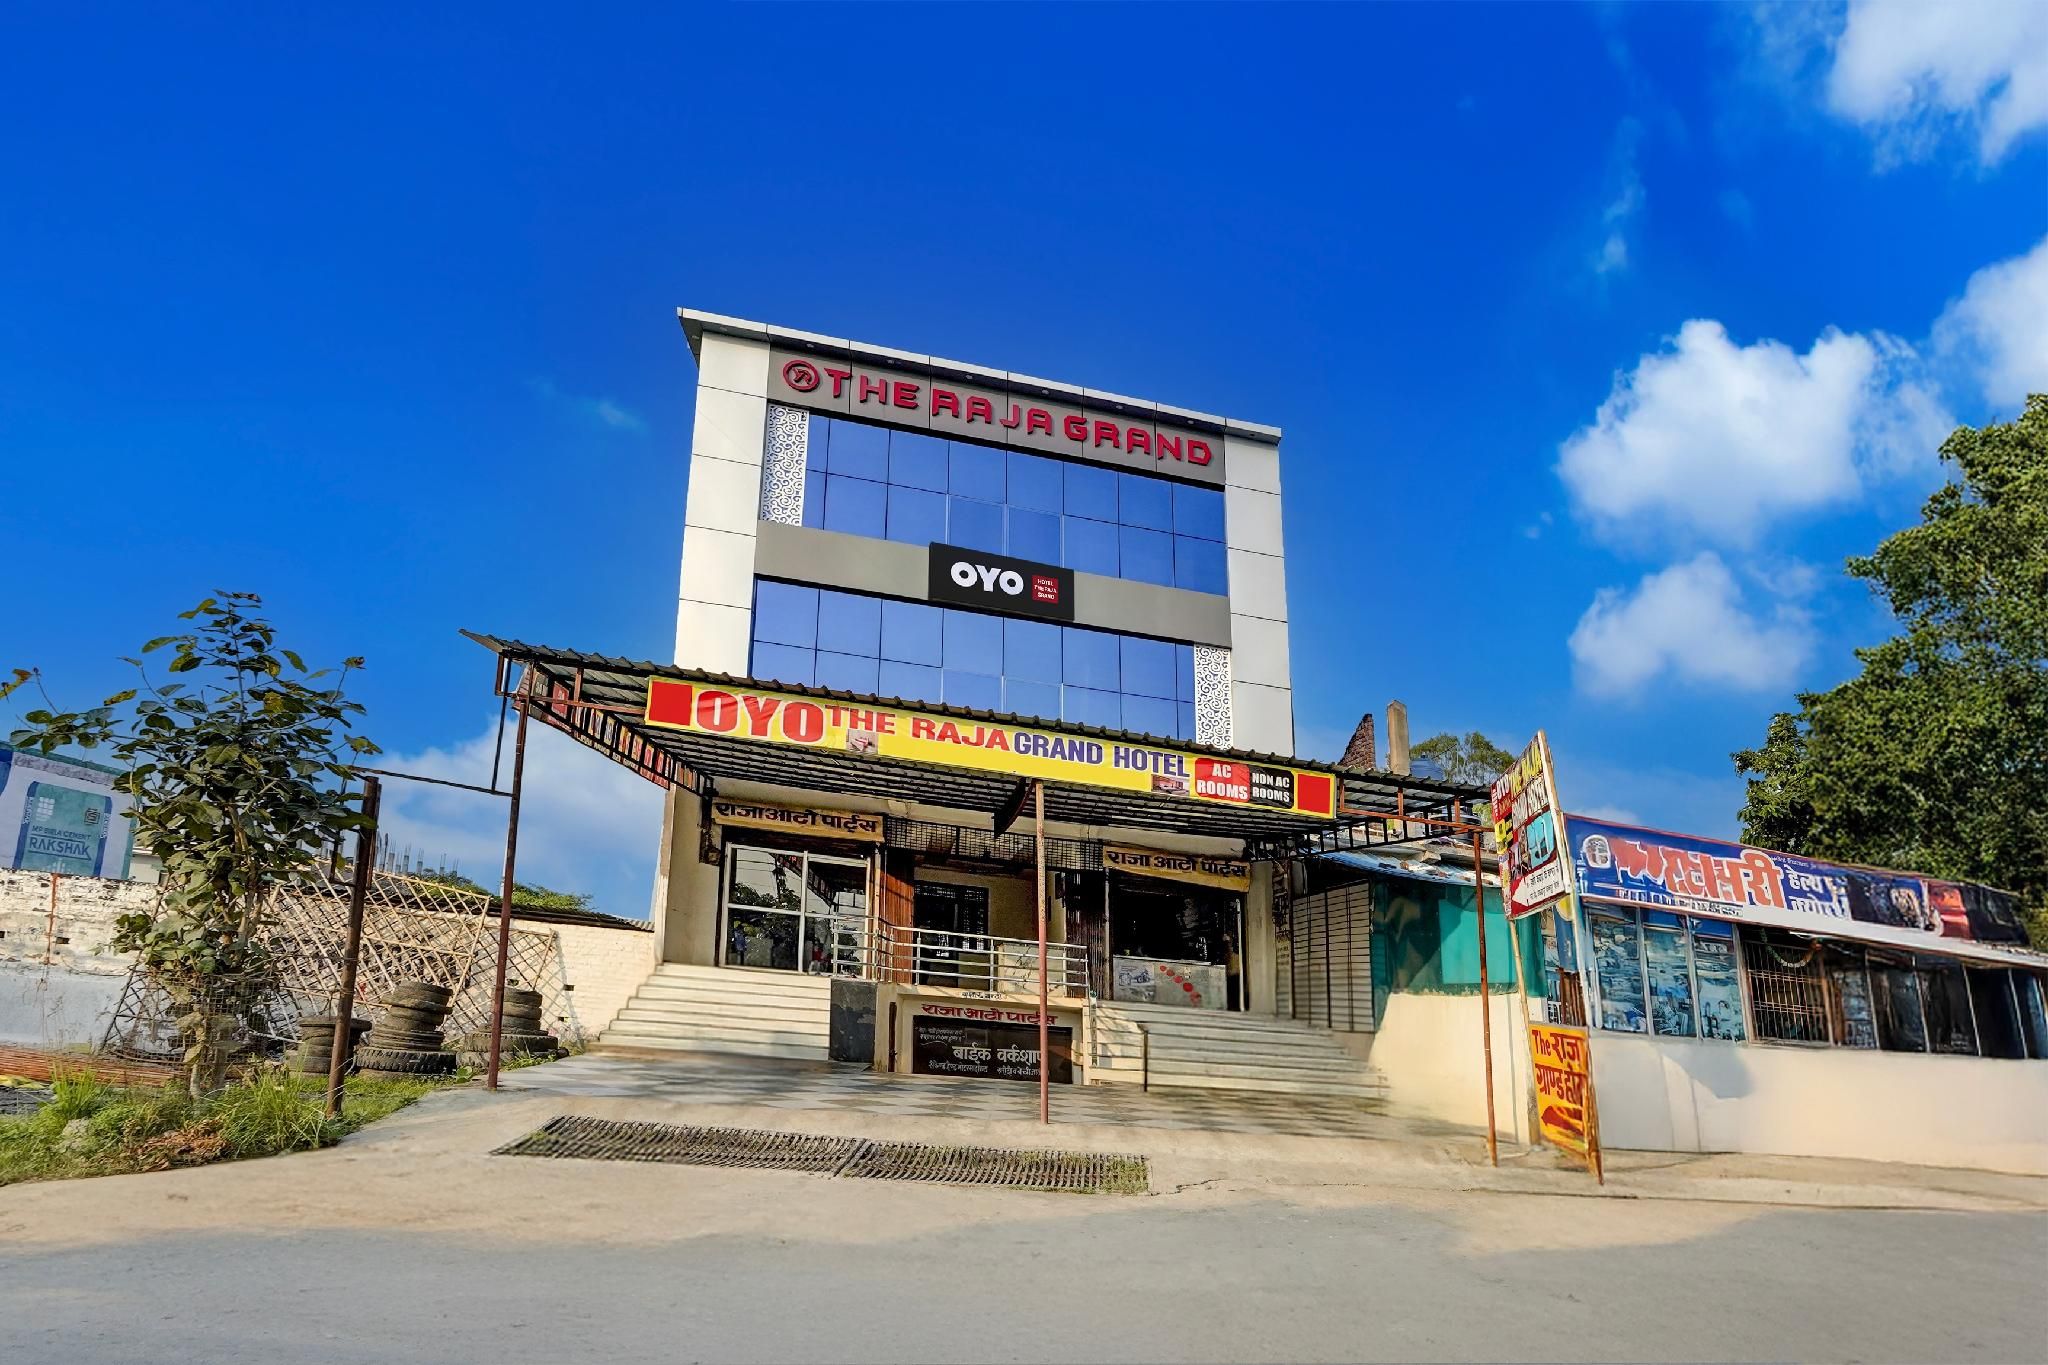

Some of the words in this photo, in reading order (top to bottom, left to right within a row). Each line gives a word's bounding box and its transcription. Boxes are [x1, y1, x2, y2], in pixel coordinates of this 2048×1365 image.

[824, 367, 920, 410] THE
[931, 388, 1053, 436] RAJA
[1063, 416, 1213, 467] GRAND
[950, 561, 1024, 596] OYO
[697, 690, 825, 743] OYO
[825, 705, 896, 735] THE
[912, 717, 1010, 752] RAJA
[1014, 732, 1103, 765] GRAND
[1114, 745, 1191, 778] HOTEL
[1212, 763, 1232, 778] AC
[1197, 779, 1249, 800] ROOMS
[1252, 772, 1274, 786] NON
[1274, 776, 1290, 789] AC
[1252, 786, 1290, 803] ROOMS
[715, 802, 764, 819] राजा
[29, 837, 90, 855] RAKSHAK
[1105, 851, 1152, 867] राजा
[921, 1003, 964, 1017] राजा
[1532, 1030, 1551, 1056] The
[952, 1042, 991, 1063] बाईक
